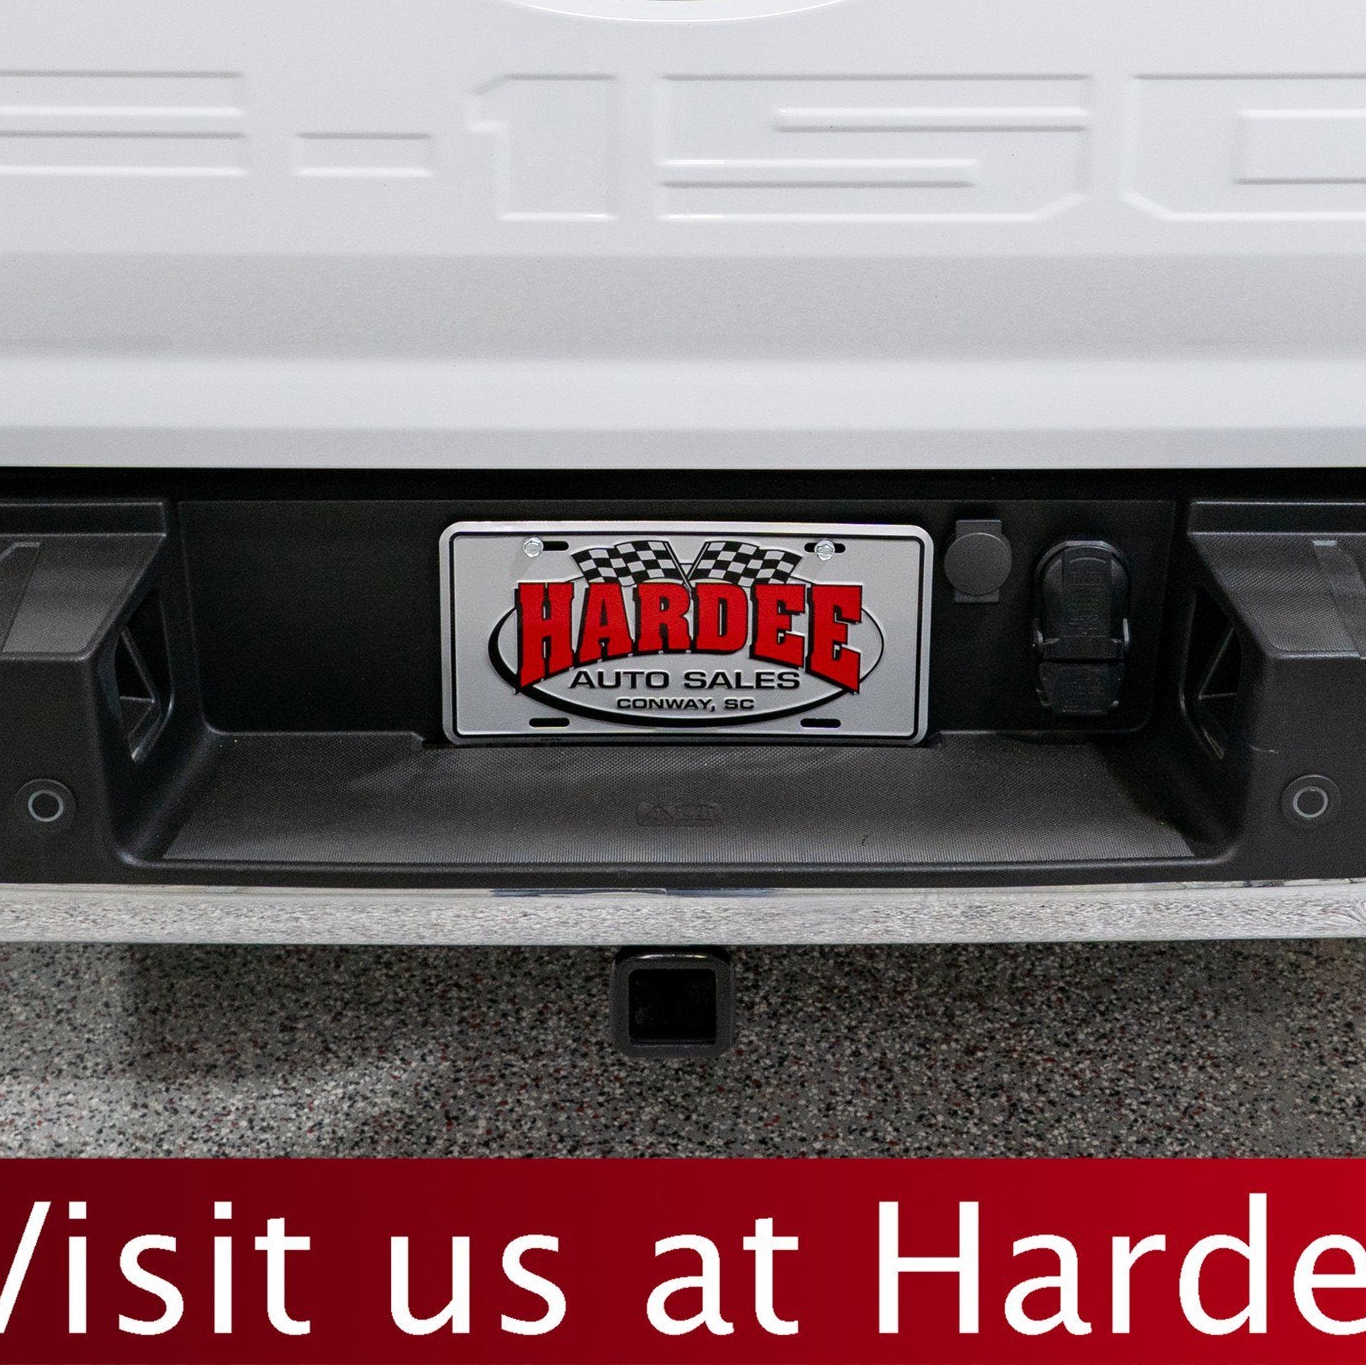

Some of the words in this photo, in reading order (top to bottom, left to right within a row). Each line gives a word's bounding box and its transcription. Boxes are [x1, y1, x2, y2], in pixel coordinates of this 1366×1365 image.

[515, 581, 863, 694] HARDEE
[569, 670, 670, 690] AUTO
[683, 670, 801, 690] SALES
[616, 697, 716, 712] CONWAY,
[724, 697, 755, 711] SC
